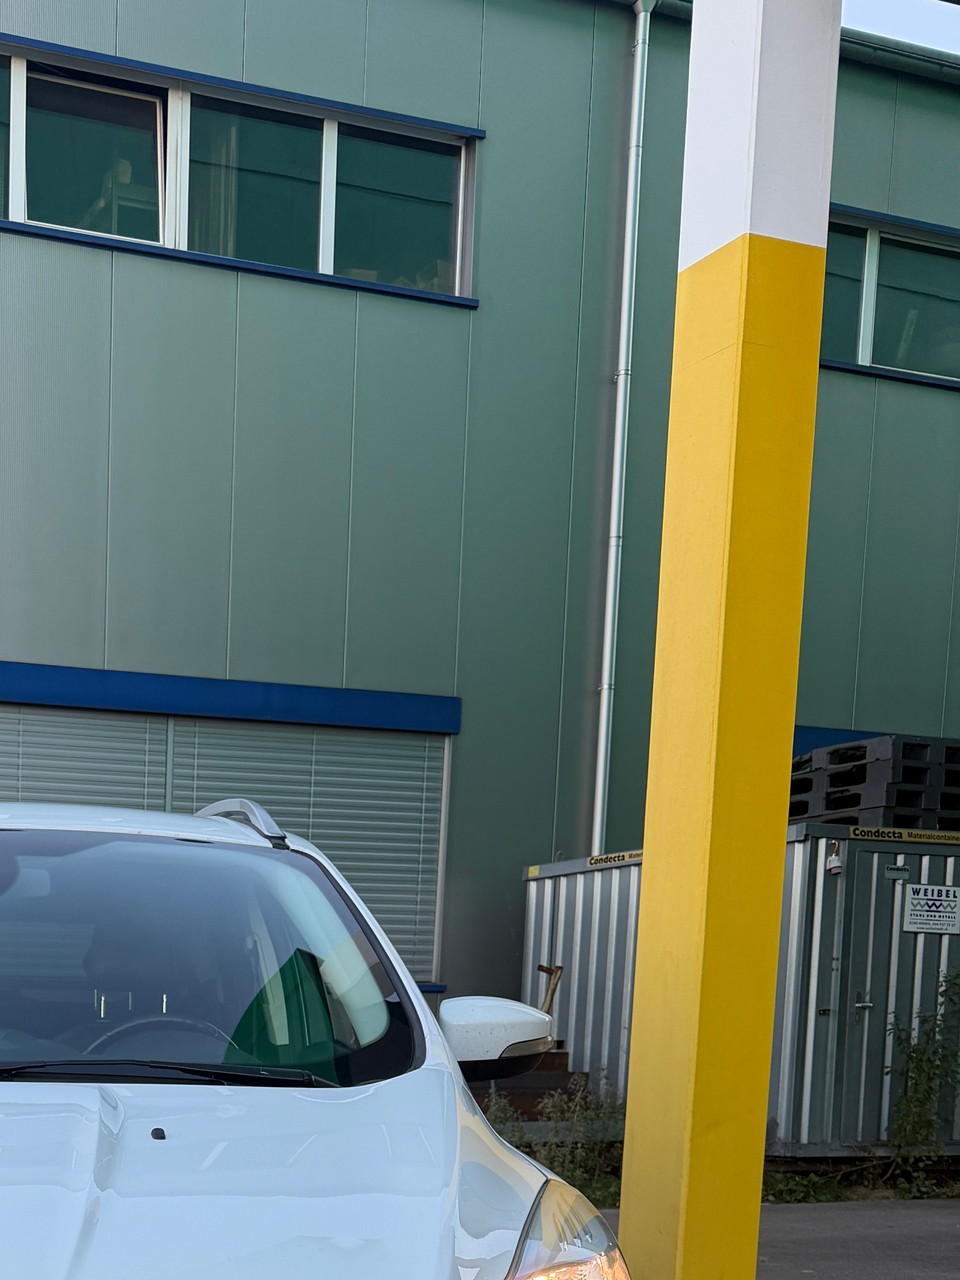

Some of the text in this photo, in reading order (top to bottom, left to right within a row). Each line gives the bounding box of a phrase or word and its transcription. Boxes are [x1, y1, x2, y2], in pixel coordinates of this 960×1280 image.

[852, 827, 903, 839] Condecta
[589, 854, 625, 866] Condecta
[912, 887, 957, 899] WEIBEL
